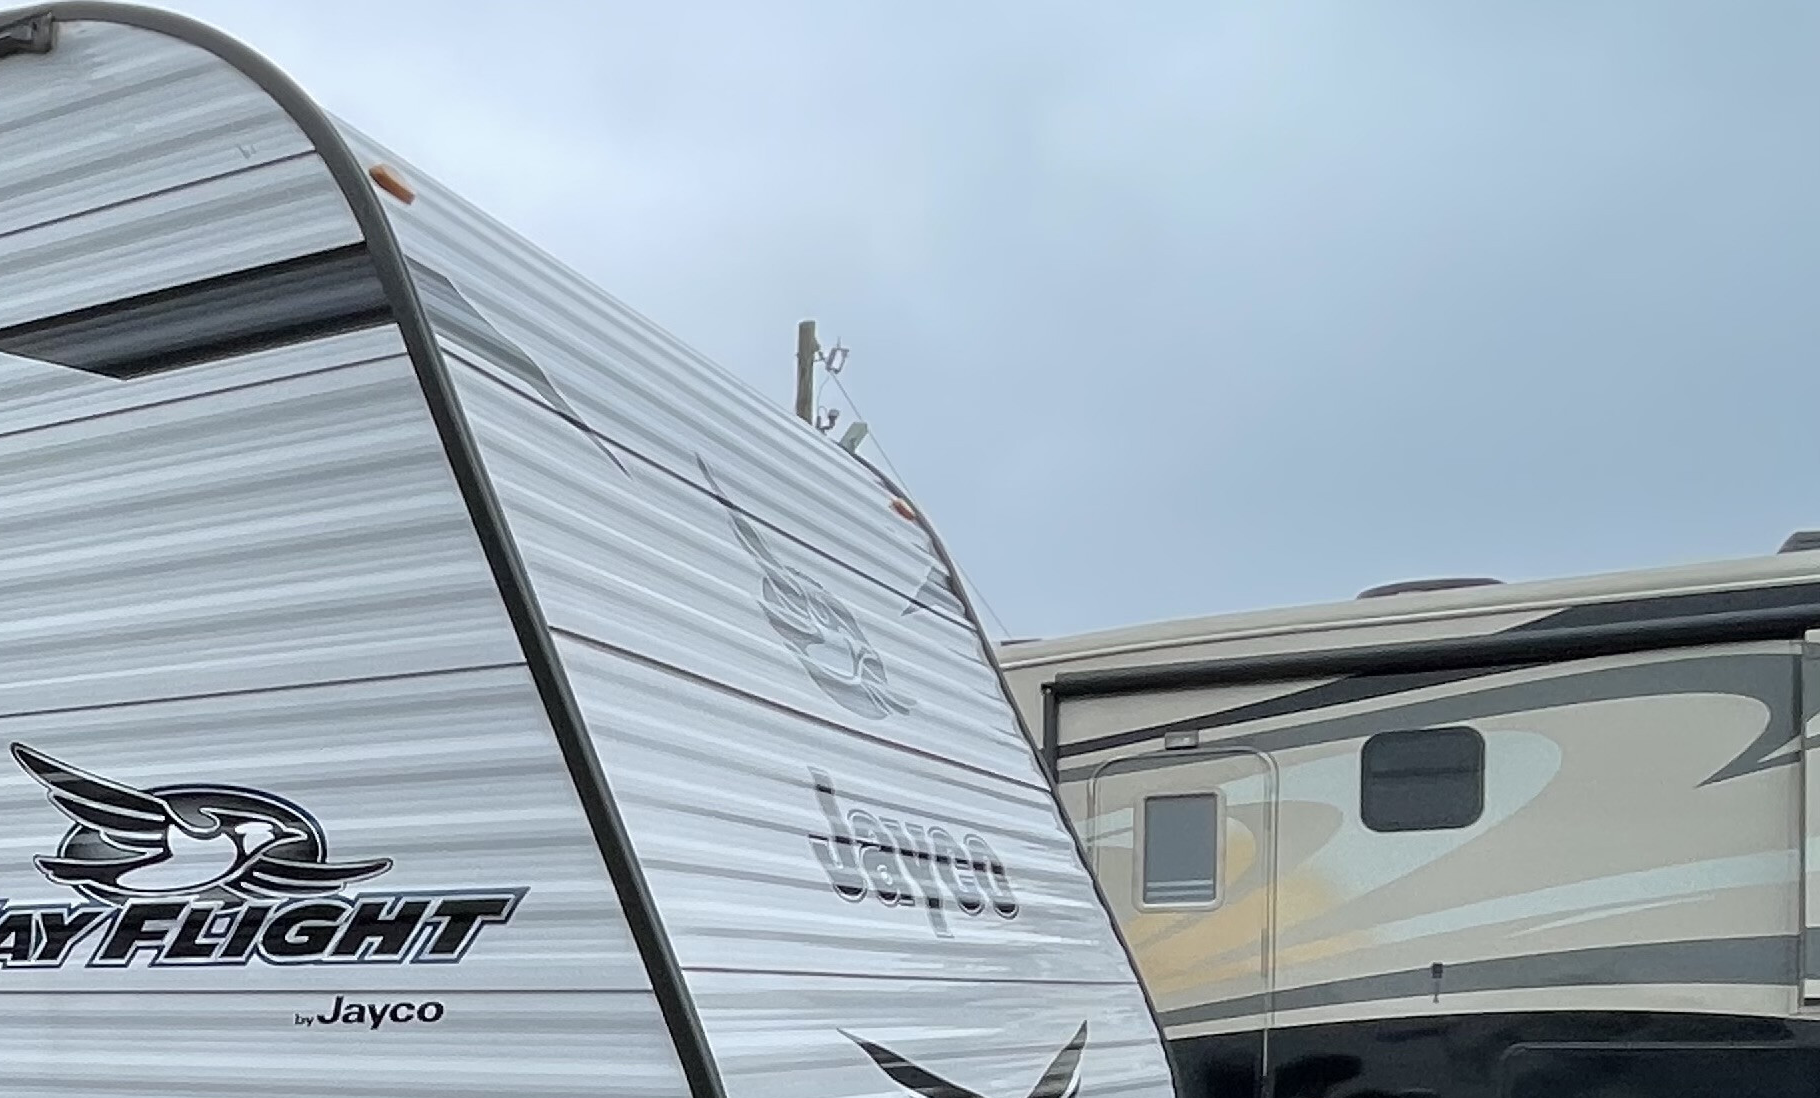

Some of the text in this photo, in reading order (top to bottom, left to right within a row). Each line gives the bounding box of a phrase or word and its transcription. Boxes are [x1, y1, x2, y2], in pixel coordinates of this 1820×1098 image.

[807, 766, 1019, 938] Jayco
[86, 886, 531, 969] FLIGHT
[294, 995, 444, 1030] by Jayco
